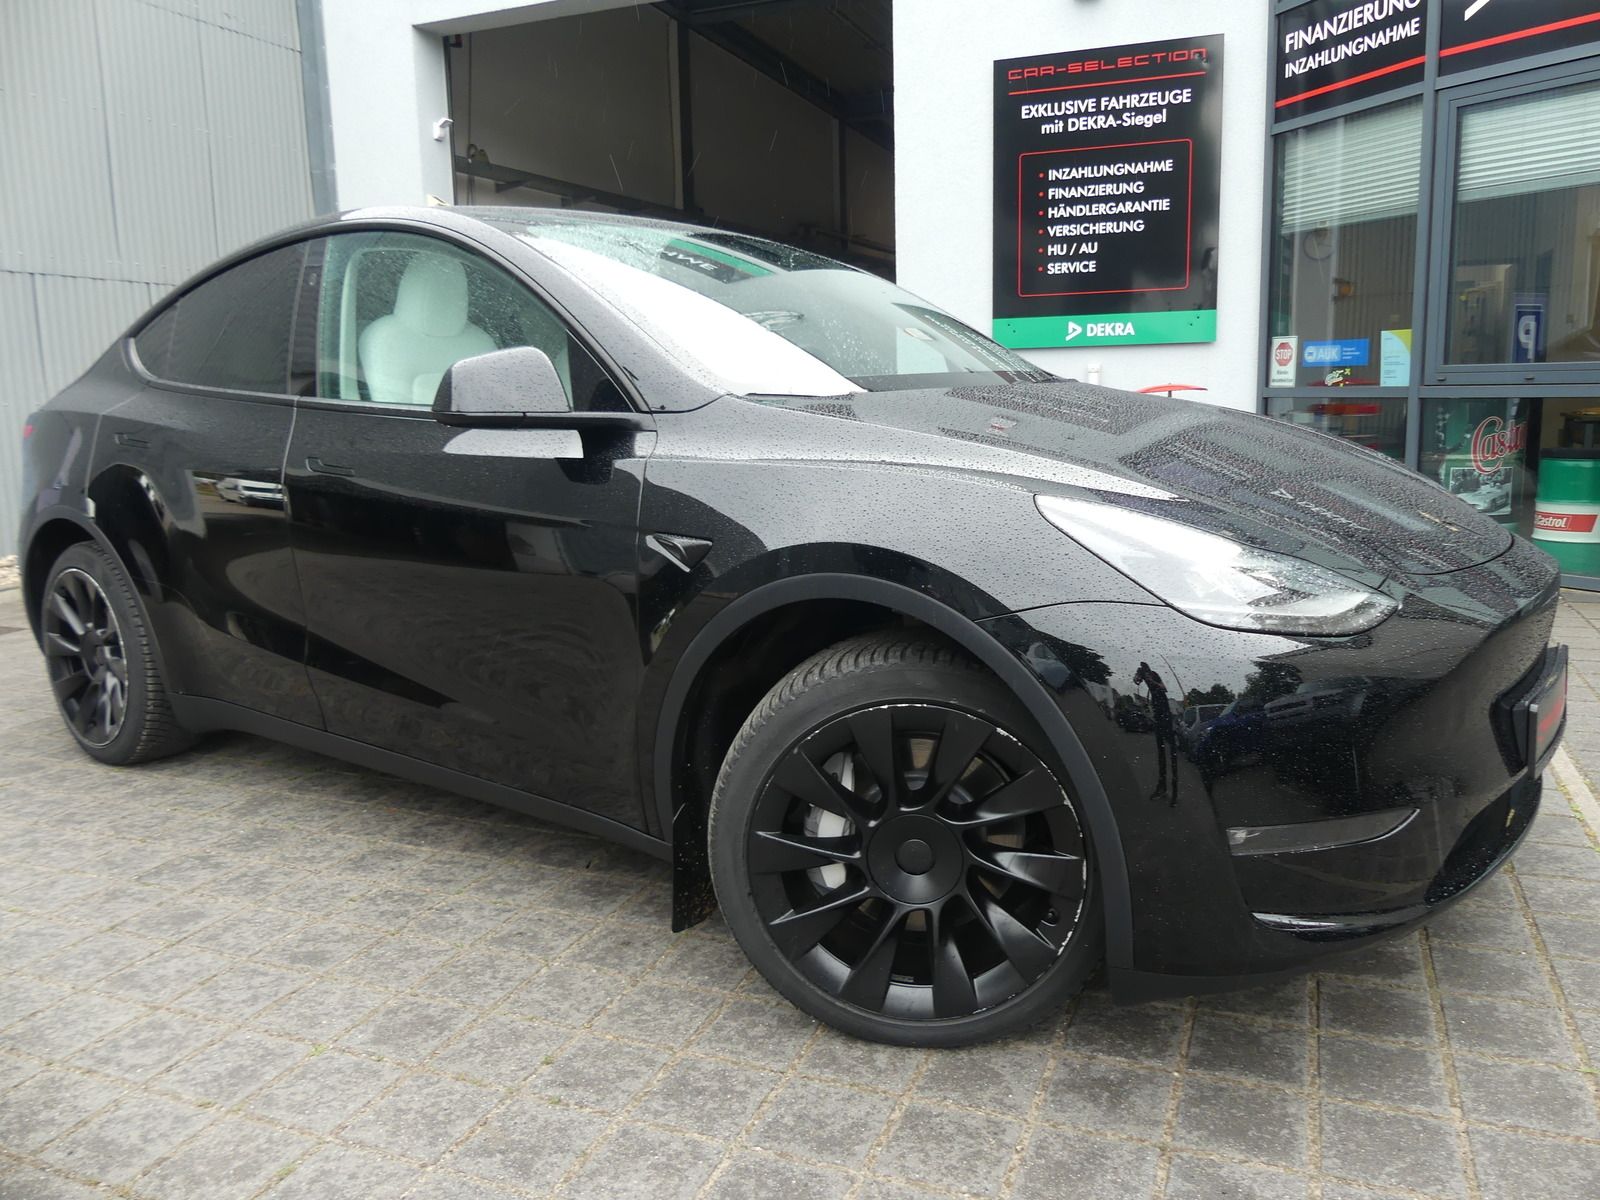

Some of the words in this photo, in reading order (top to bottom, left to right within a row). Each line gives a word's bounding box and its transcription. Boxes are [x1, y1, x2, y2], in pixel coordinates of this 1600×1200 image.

[1284, 17, 1421, 78] INZAHLUNGNAHME
[1021, 98, 1097, 120] EXKLUSIVE
[1100, 88, 1192, 111] FAHRZEUGE
[1041, 119, 1065, 135] mit
[1067, 109, 1167, 132] DEKRA-Siegel
[1048, 159, 1174, 181] INZAHLUNGNAHME
[1048, 181, 1145, 200] FINANZIERUNG
[1047, 198, 1171, 219] HÄNDLERGARANTIE
[1047, 219, 1145, 238] VERSICHERUNG
[1047, 243, 1067, 256] HU
[1078, 241, 1099, 254] AU
[1047, 260, 1097, 275] SERVICE
[1086, 322, 1136, 337] DEKRA
[1275, 349, 1292, 361] STOP
